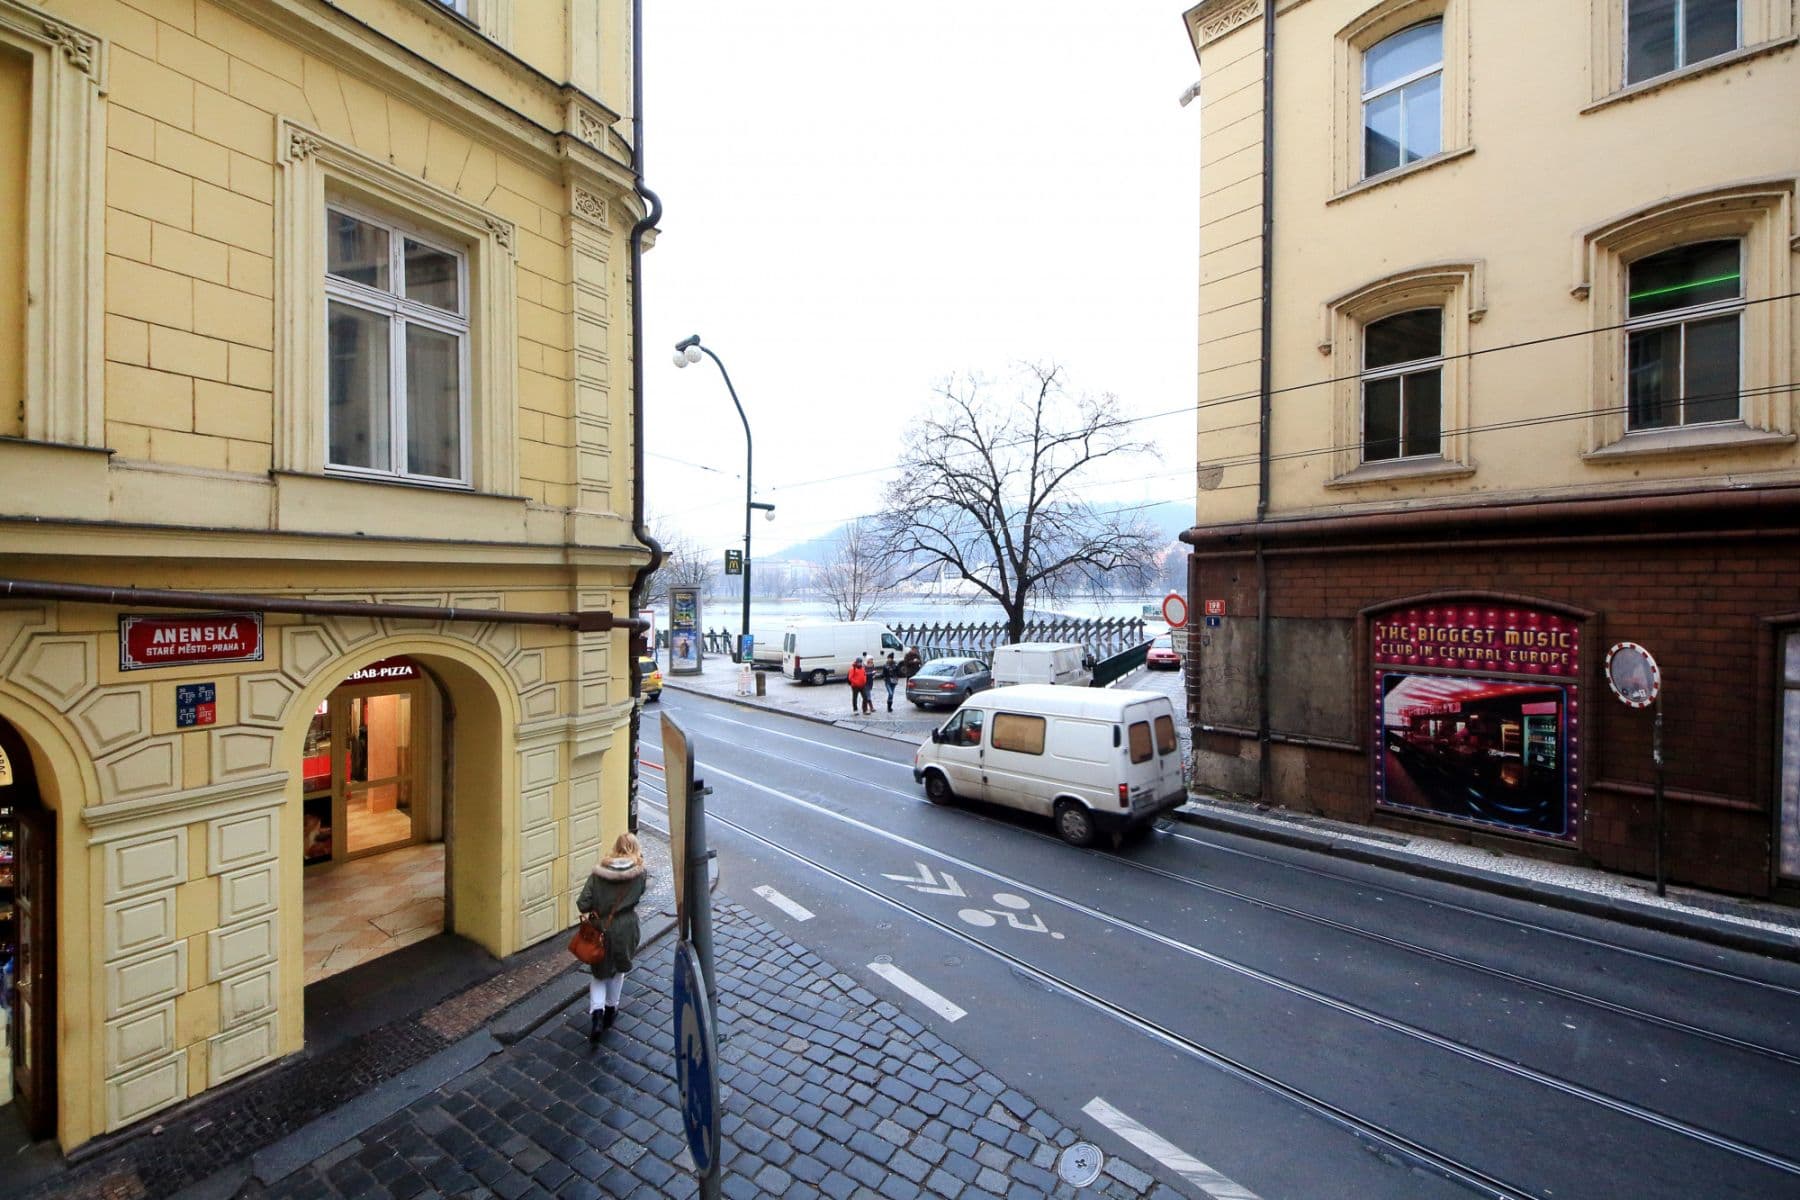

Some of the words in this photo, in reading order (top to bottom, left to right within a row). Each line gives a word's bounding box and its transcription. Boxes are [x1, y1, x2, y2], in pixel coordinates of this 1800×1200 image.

[152, 623, 239, 644] ANENSKÁ
[1380, 625, 1409, 640] THE
[1505, 630, 1570, 648] MUSIC
[146, 644, 176, 656] STARÉ
[1381, 643, 1413, 655] CLUB
[1420, 645, 1433, 657] IN
[1440, 646, 1502, 661] CENTRAL
[1510, 650, 1569, 665] EUROPE
